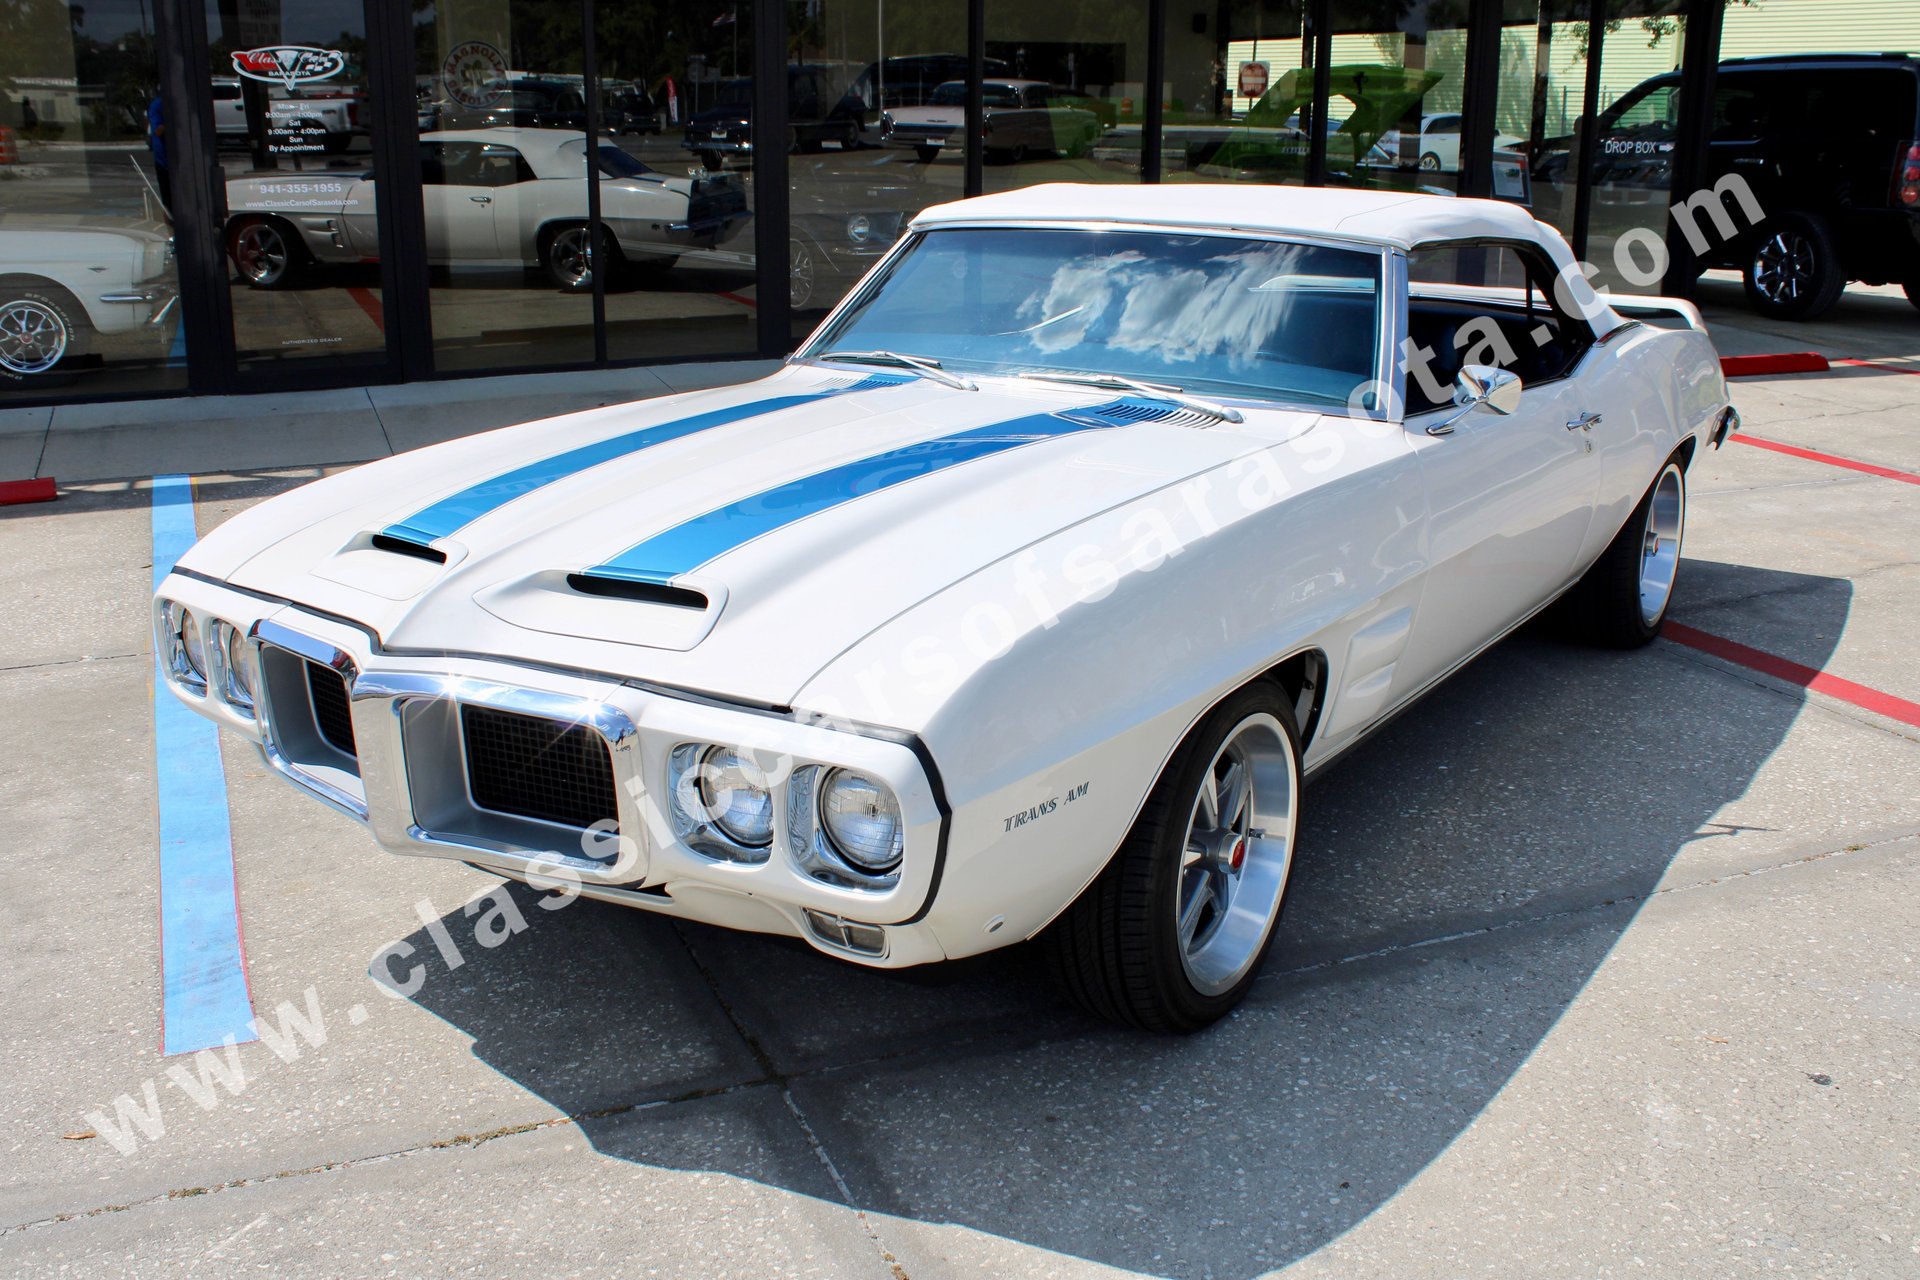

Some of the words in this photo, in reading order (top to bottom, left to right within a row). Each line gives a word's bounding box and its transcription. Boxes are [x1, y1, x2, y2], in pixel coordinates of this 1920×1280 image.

[289, 119, 301, 127] Sat
[300, 128, 326, 136] 4:00pm
[280, 144, 325, 152] Appointment
[1605, 141, 1634, 154] DROP
[1635, 141, 1656, 154] BOX
[260, 183, 342, 194] 941-355-1955
[1004, 797, 1059, 832] TRANS
[1063, 781, 1090, 805] AM
